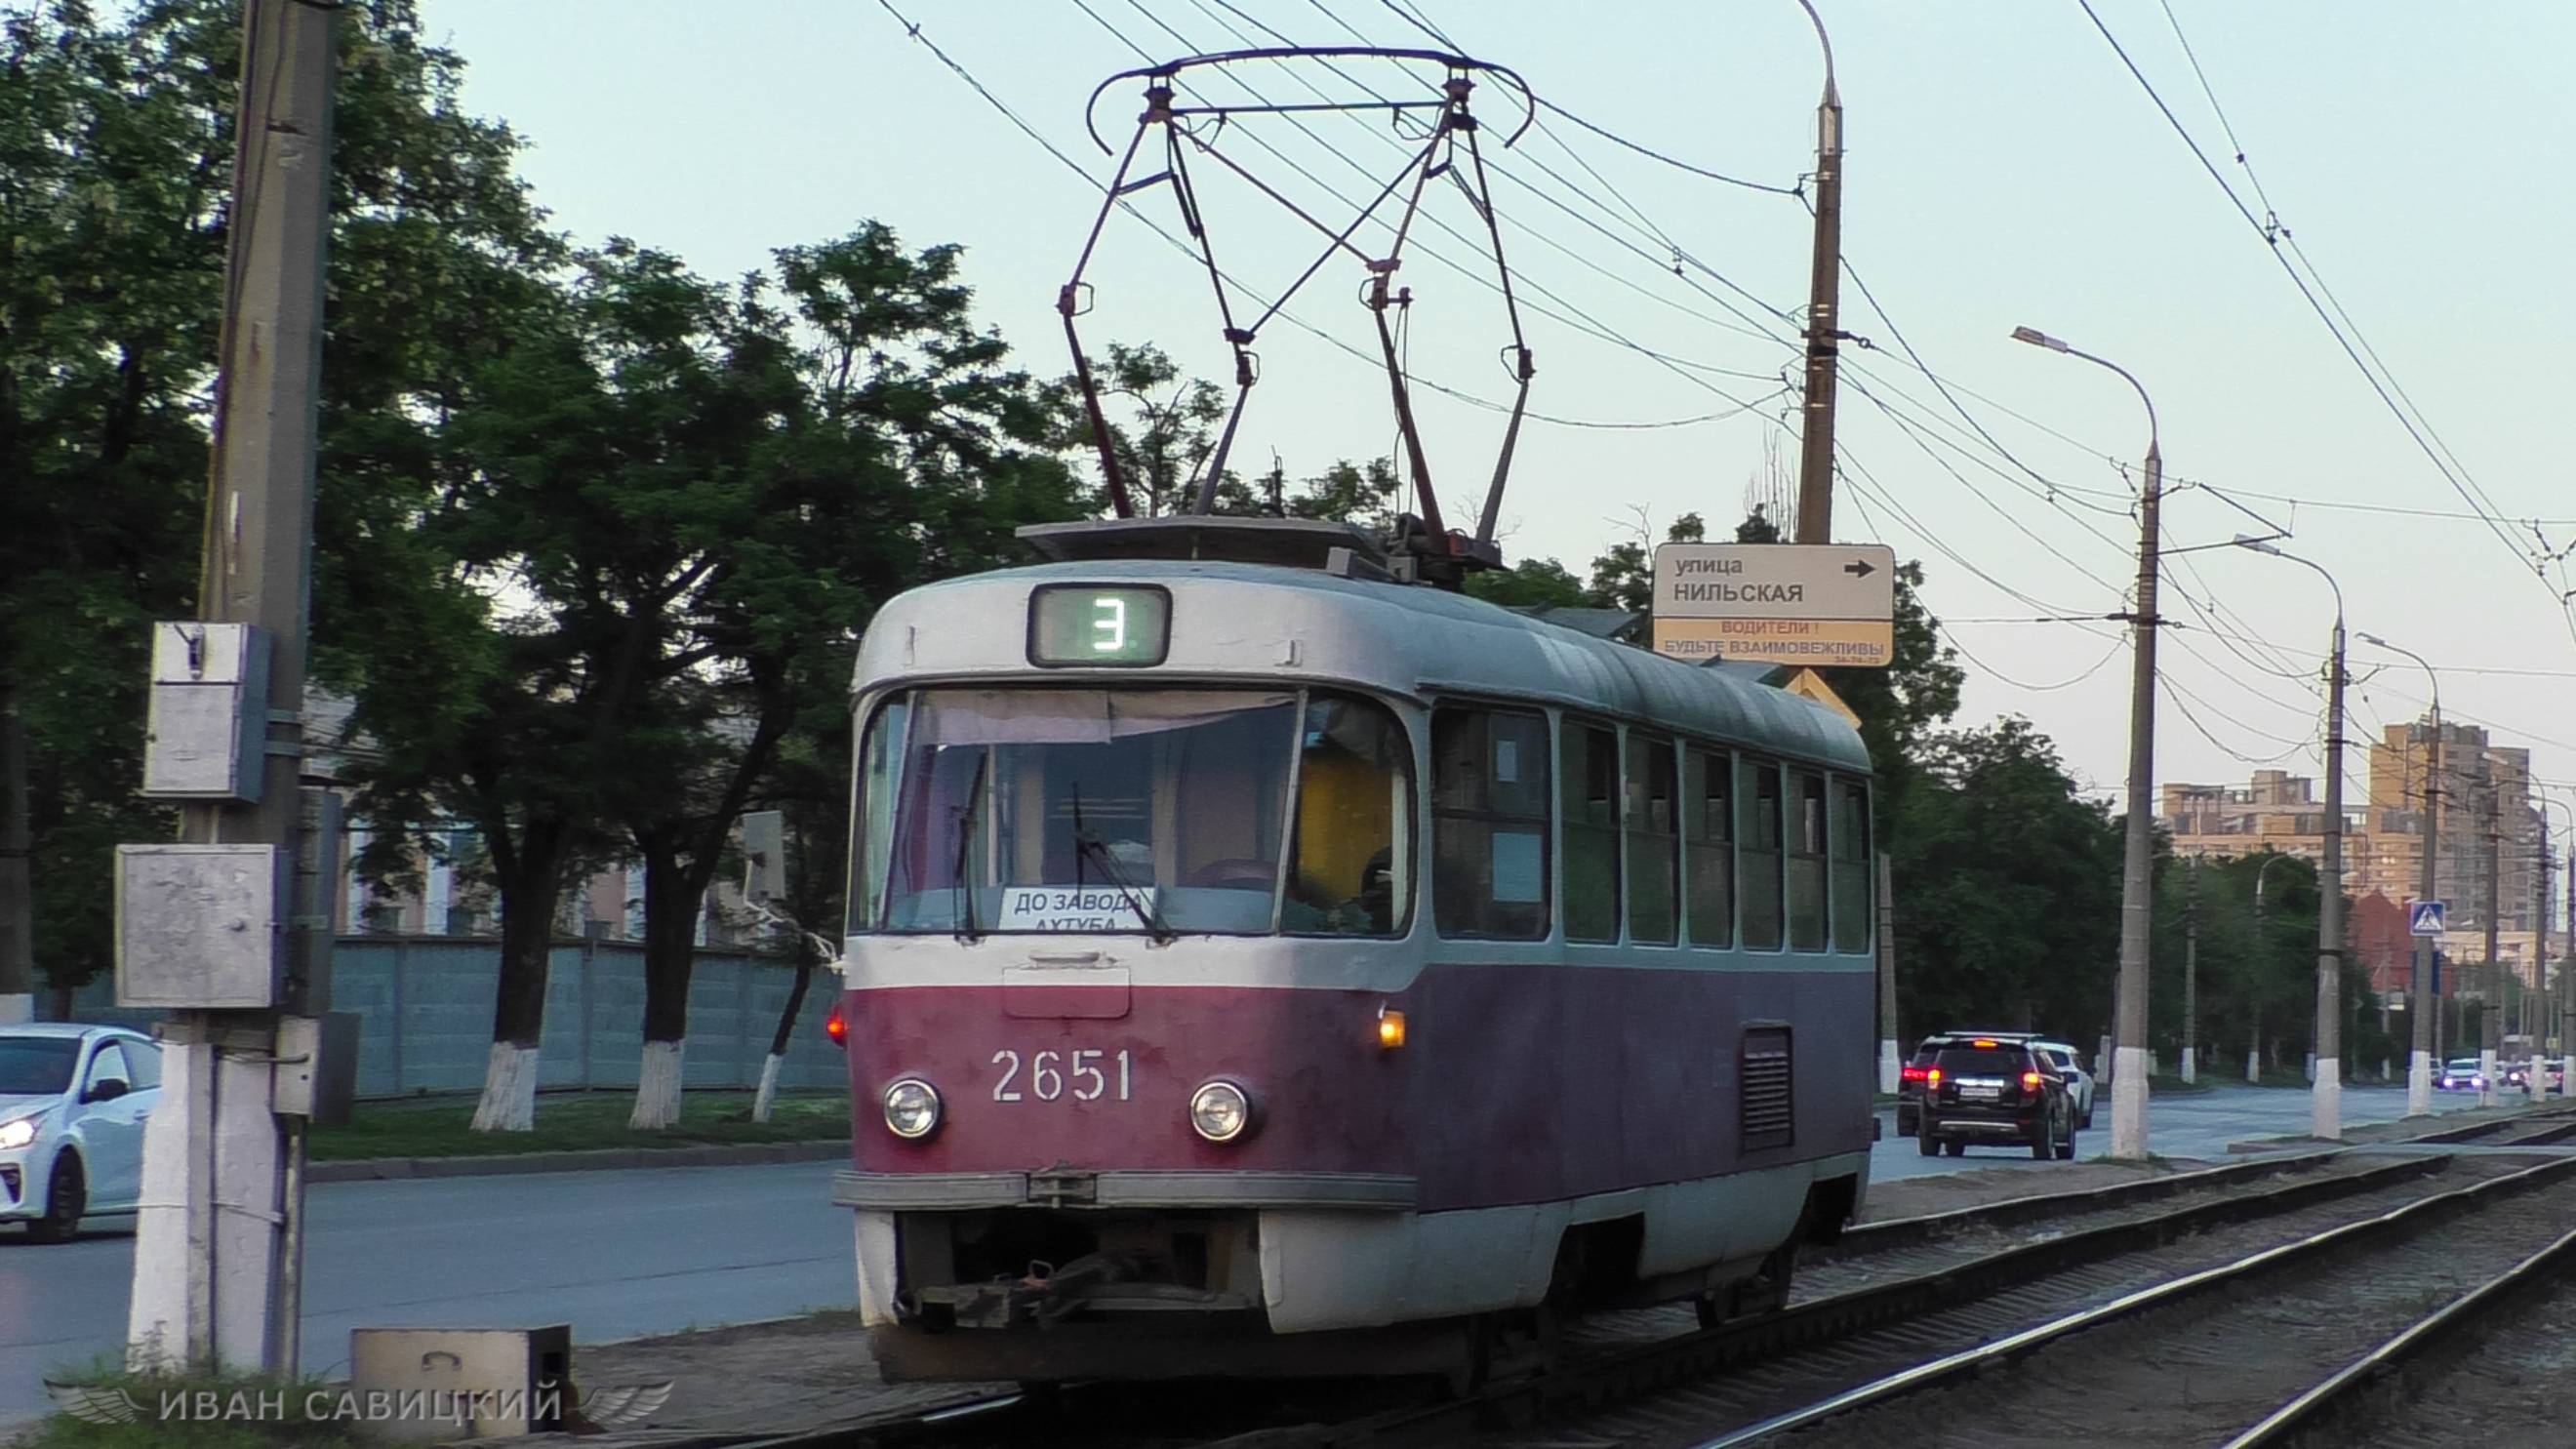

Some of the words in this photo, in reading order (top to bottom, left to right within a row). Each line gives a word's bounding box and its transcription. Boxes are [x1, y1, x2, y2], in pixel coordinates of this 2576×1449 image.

[1675, 559, 1743, 577] улица
[1673, 584, 1803, 602] НИЛЬСКАЯ
[1094, 598, 1125, 650] 3
[1721, 622, 1809, 634] ВОДИТЕЛИ
[1665, 640, 1723, 654] БУДЬТЕ
[1730, 640, 1884, 655] ВЗАИМОВЕЖЛИВЫ
[1015, 894, 1047, 914] ДО
[1054, 894, 1142, 912] ЗАВОДА
[992, 1050, 1129, 1101] 2651
